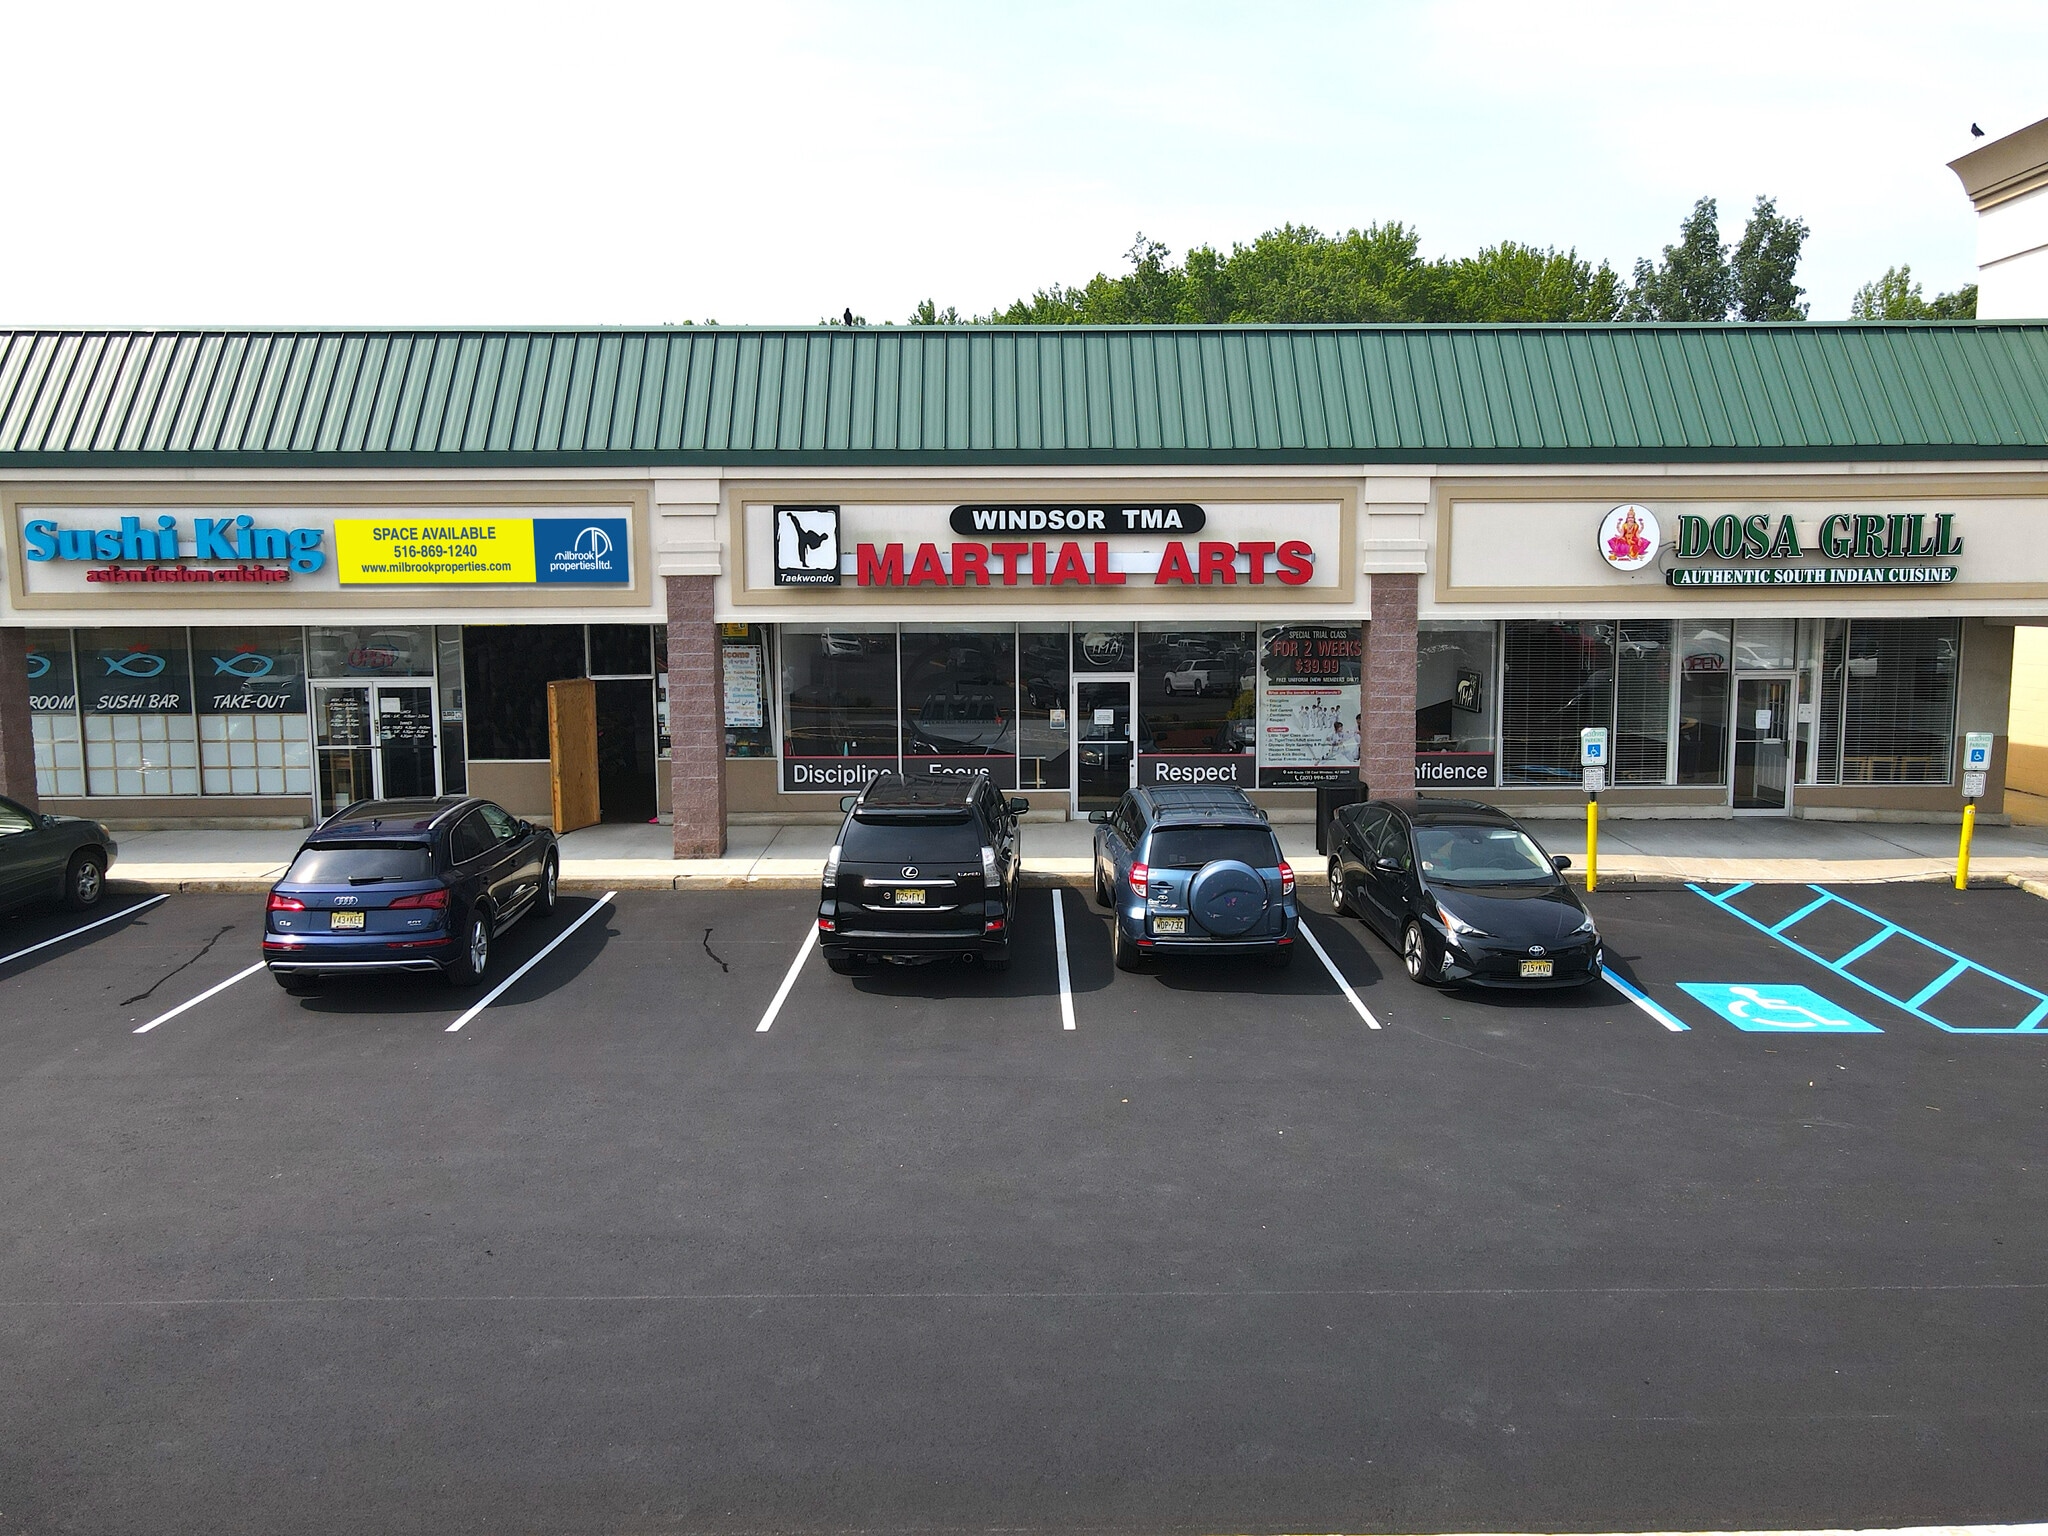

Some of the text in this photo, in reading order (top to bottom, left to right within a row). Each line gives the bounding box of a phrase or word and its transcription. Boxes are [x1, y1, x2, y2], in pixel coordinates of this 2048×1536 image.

[971, 508, 1182, 530] WINDSOR TMA
[373, 526, 497, 541] SPACE AVAILABLE
[1676, 512, 1964, 560] DOSA GRILL
[24, 514, 326, 574] Sushi King
[393, 544, 477, 558] 516-869-1240
[555, 551, 595, 560] milbrook
[856, 540, 1315, 587] MARTIAL ARTS
[87, 565, 288, 582] asian fusion cuisine
[361, 561, 512, 574] www.milbrookproperties.com
[550, 560, 596, 572] properties
[780, 573, 835, 583] Taekwondo
[1680, 567, 1951, 584] AUTHENTIC SOUTH INDIAN CUISINE
[1289, 631, 1311, 639] SPECIAL
[723, 650, 750, 658] lcome
[1273, 640, 1362, 657] FOR 2 WEEKS
[29, 695, 75, 710] ROOM
[97, 693, 180, 710] SUSHI BAR
[212, 694, 290, 709] TAKE-OUT
[1155, 762, 1237, 784] Respect
[1415, 762, 1488, 780] nfidence
